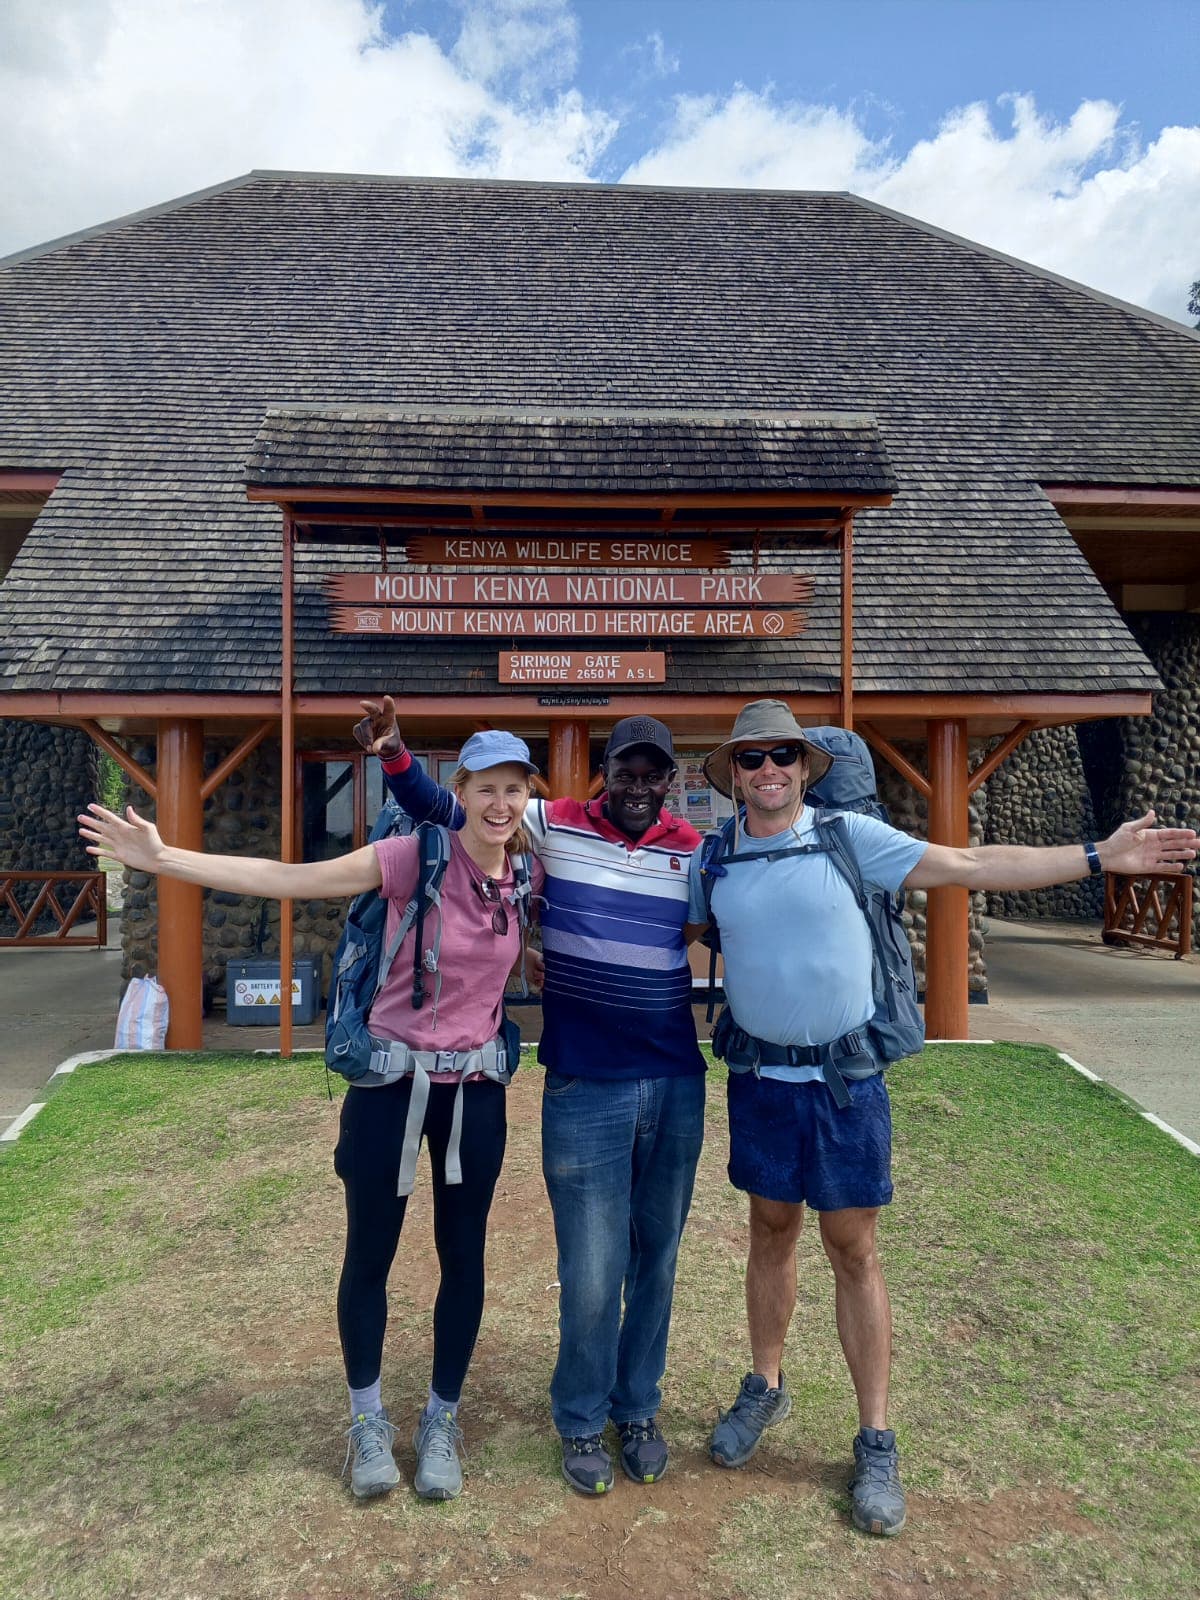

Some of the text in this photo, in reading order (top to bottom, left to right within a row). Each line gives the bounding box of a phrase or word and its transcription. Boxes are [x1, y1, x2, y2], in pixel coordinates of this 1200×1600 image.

[445, 540, 693, 562] KENYA WILDLIFE SERVICE
[375, 575, 763, 601] MOUNT KENYA NATIONAL PARK
[391, 610, 754, 634] MOUNT KENYA WORLD HERITAGE AREA
[510, 655, 621, 668] SIRIMON GATE
[510, 668, 568, 680] ALTITUDE
